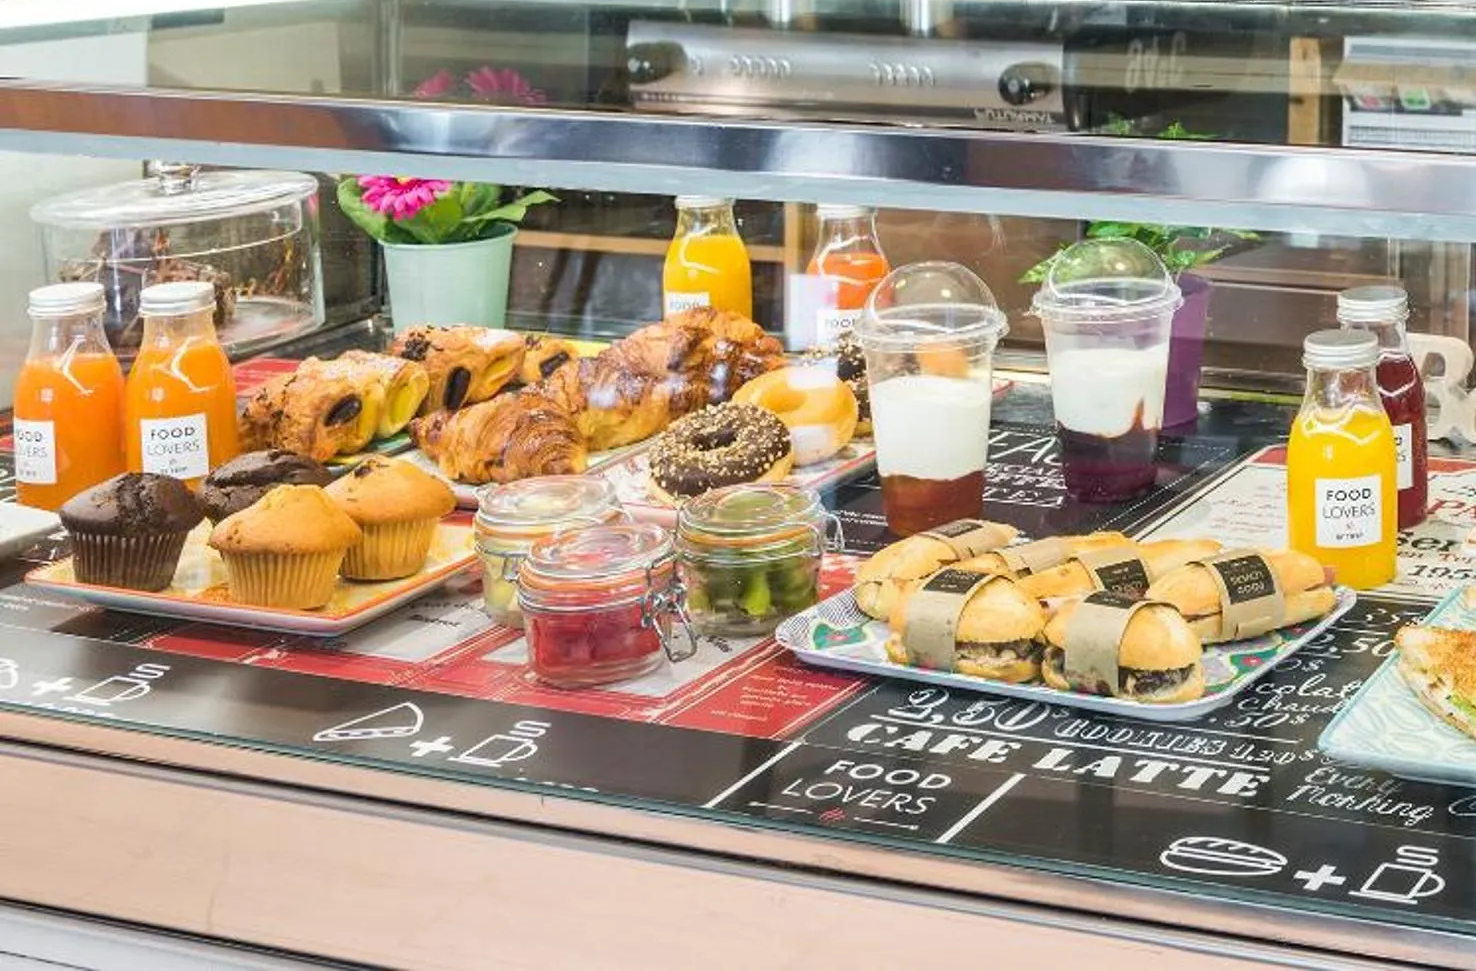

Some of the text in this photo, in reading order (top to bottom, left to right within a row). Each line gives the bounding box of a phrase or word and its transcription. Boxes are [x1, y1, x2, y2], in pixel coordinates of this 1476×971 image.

[150, 426, 196, 440] FOOD
[1326, 488, 1372, 502] FOOD
[823, 759, 952, 789] FOOD
[847, 722, 1271, 798] CAFE LATTE
[781, 777, 937, 815] LOVERS
